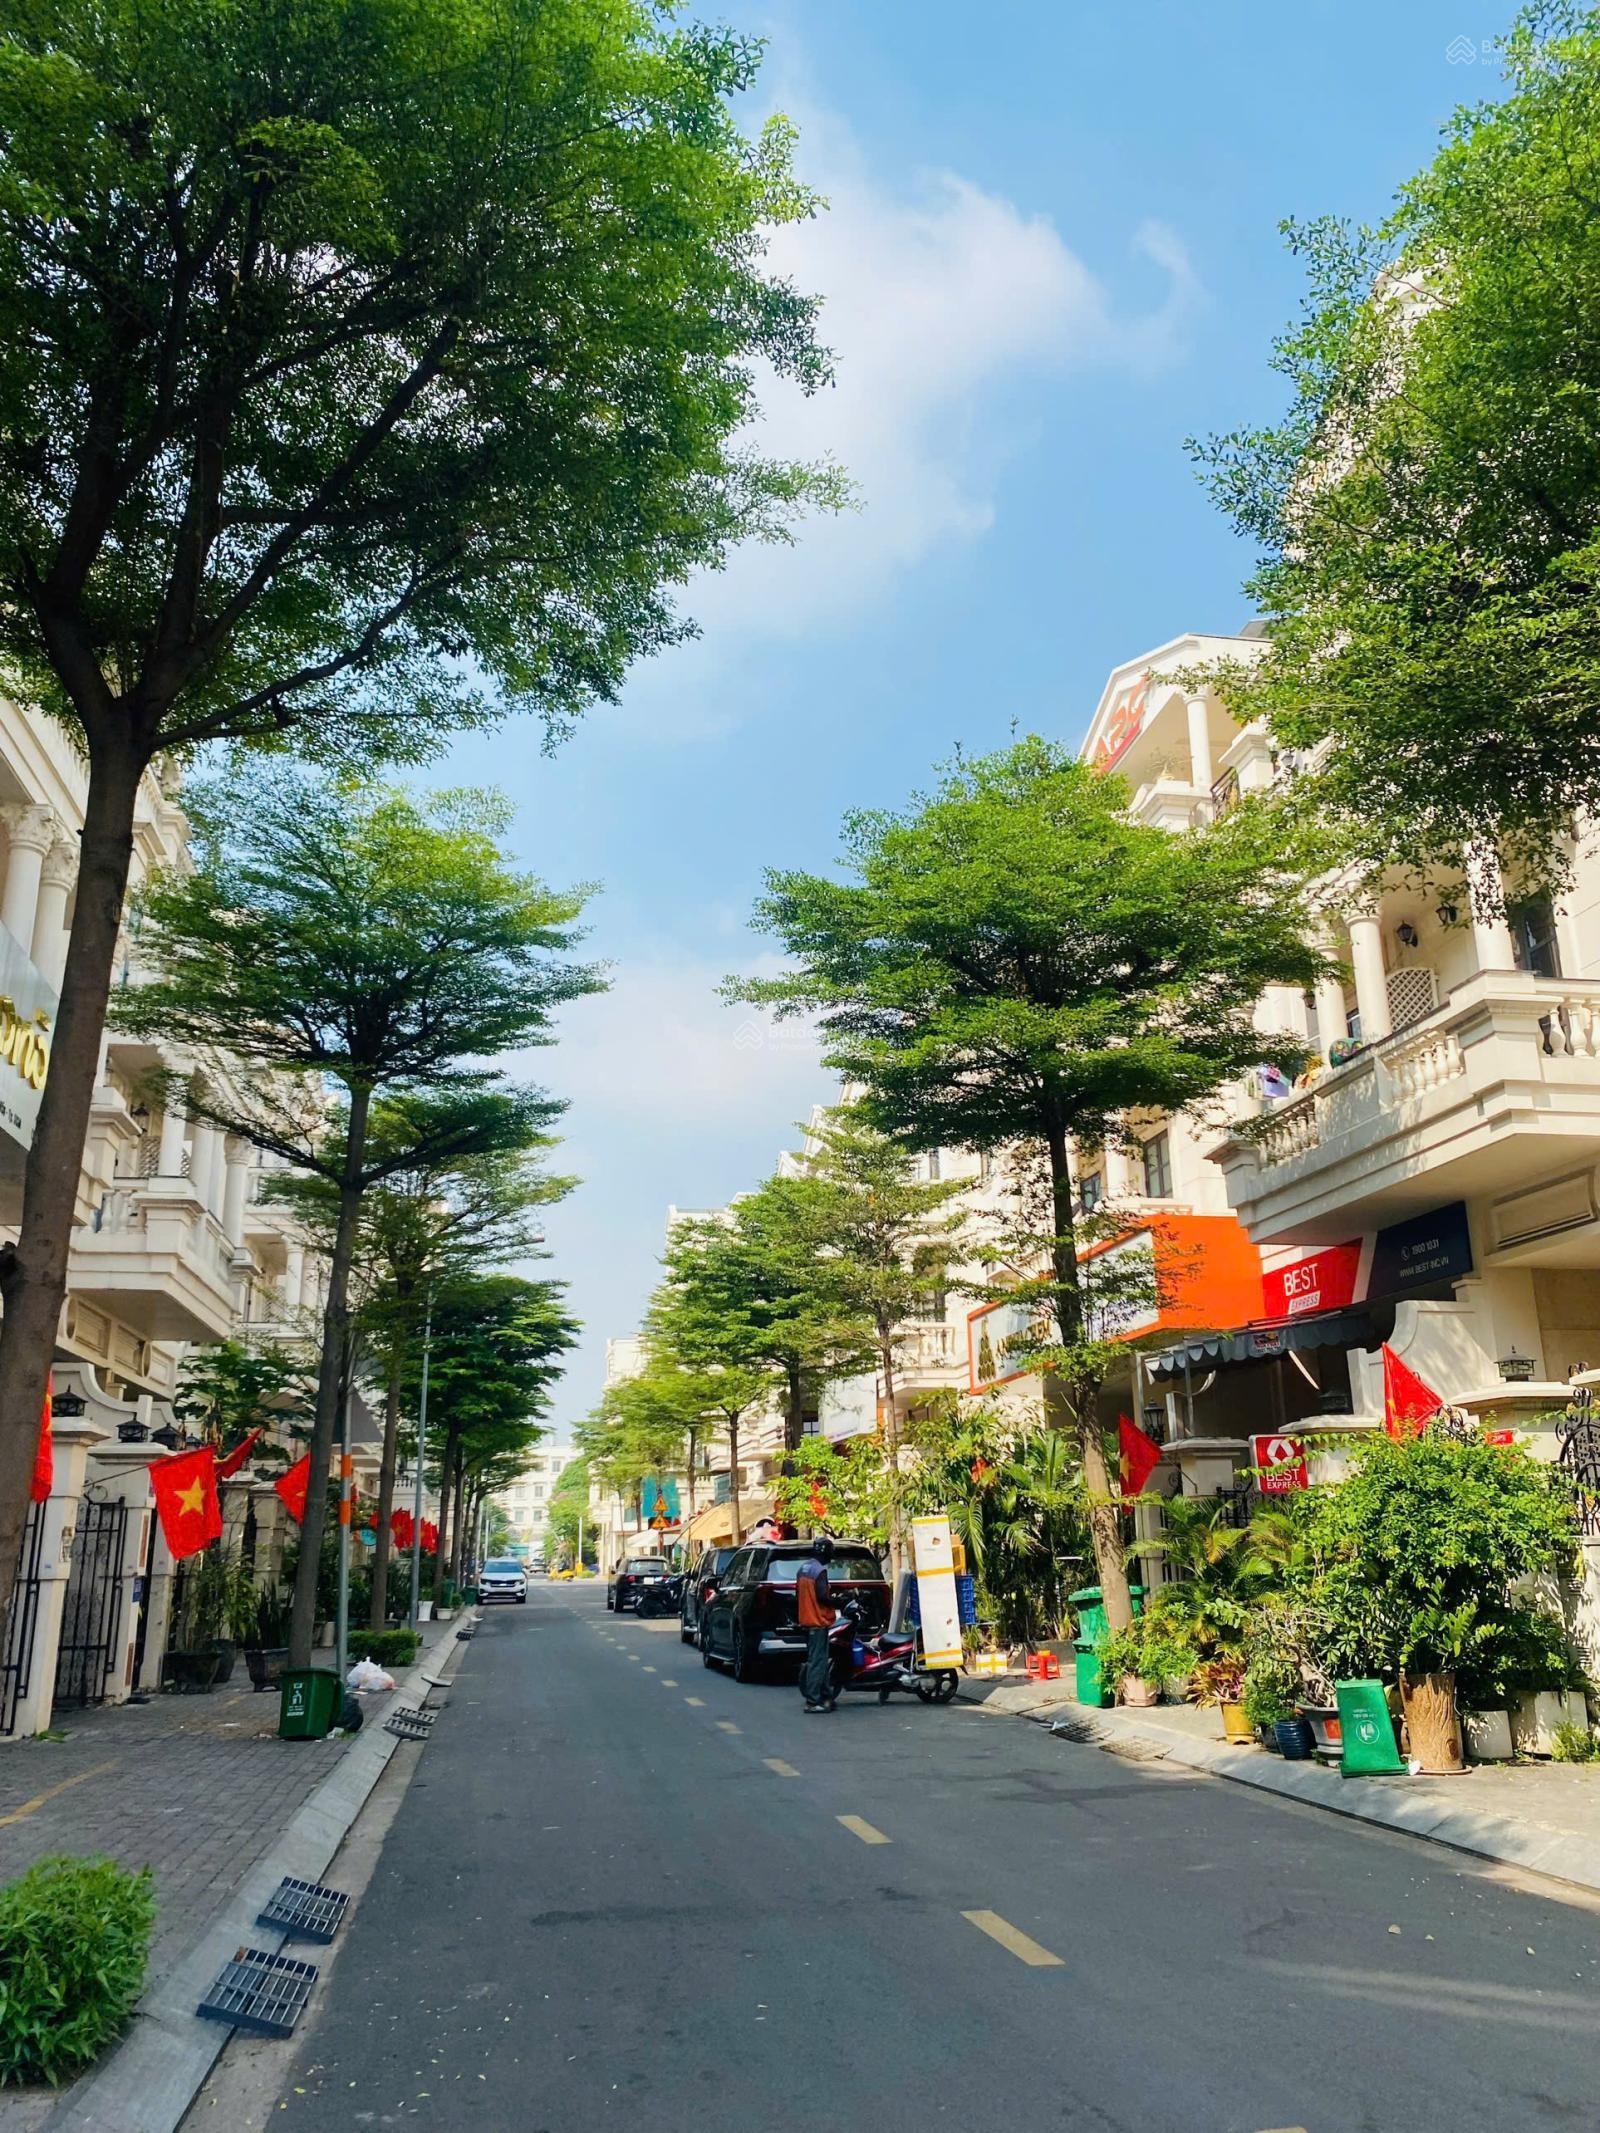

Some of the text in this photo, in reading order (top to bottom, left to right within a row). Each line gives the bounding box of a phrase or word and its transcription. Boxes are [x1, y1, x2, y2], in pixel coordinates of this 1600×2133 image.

[1283, 1263, 1318, 1297] BEST
[1291, 1293, 1319, 1312] EXPRESS
[1266, 1467, 1300, 1482] BEST
[1267, 1480, 1302, 1490] EXPRESS
